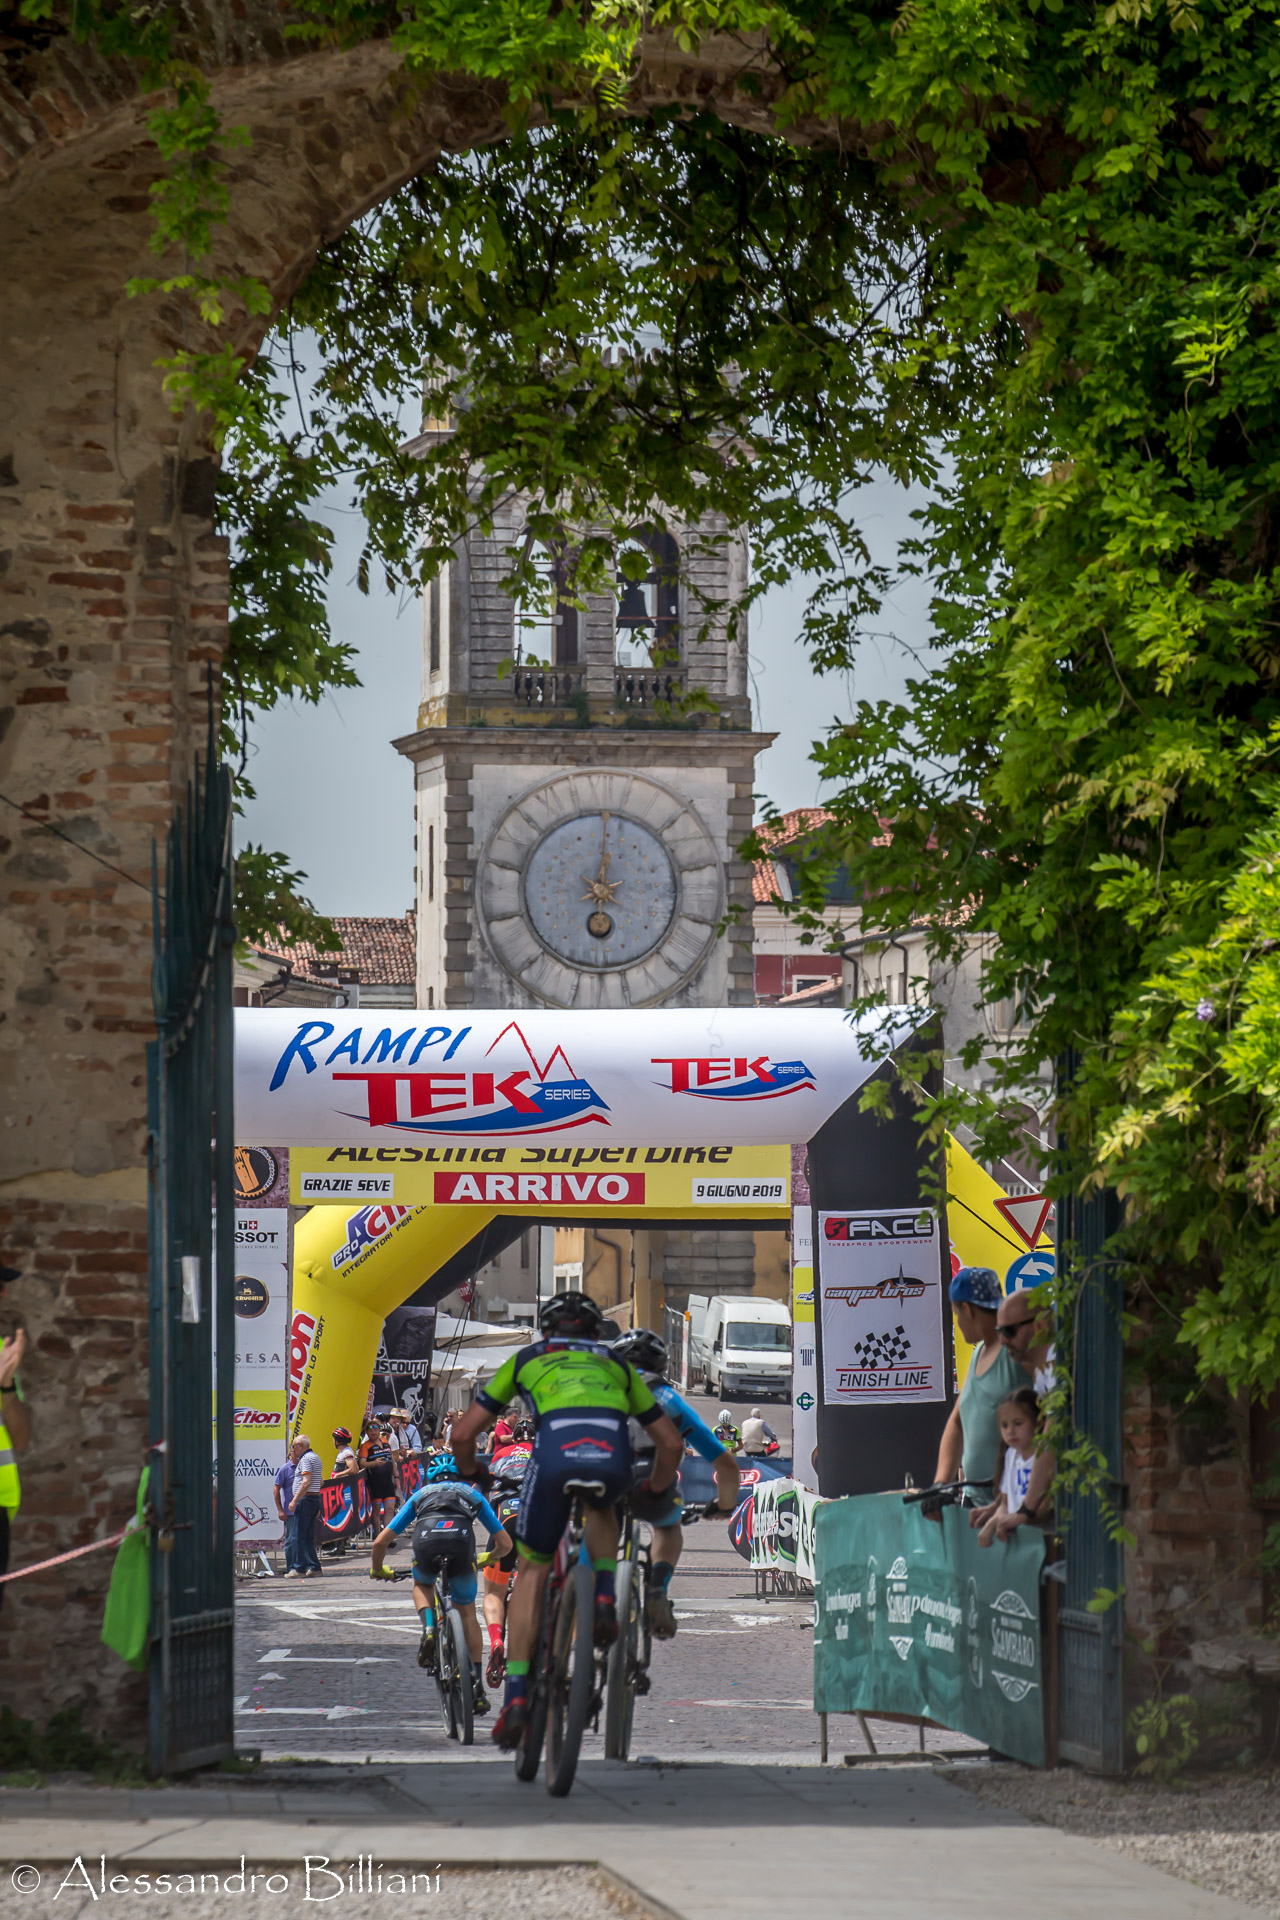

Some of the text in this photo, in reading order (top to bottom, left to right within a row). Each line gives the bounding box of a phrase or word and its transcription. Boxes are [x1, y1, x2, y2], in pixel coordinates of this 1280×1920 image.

[269, 1021, 472, 1091] RAMPI
[651, 1056, 777, 1093] TEK
[777, 1066, 806, 1074] SERIES
[332, 1071, 543, 1127] TEK
[544, 1088, 591, 1100] SERIES
[304, 1178, 390, 1191] GRAZIE SEVE
[450, 1174, 629, 1201] ARRIVO
[697, 1185, 783, 1197] 9 GIUGNO 2019
[849, 1218, 932, 1238] FACE
[333, 1240, 360, 1269] PRO
[342, 1231, 394, 1279] INTEGRATORI
[396, 1215, 413, 1232] PER
[313, 1315, 327, 1351] SPORT
[309, 1354, 318, 1370] LO
[303, 1374, 313, 1395] PER
[840, 1372, 929, 1387] FINISH LINE
[234, 1411, 282, 1424] ction
[234, 1458, 269, 1468] ANCA
[234, 1467, 281, 1477] ATAVIN
